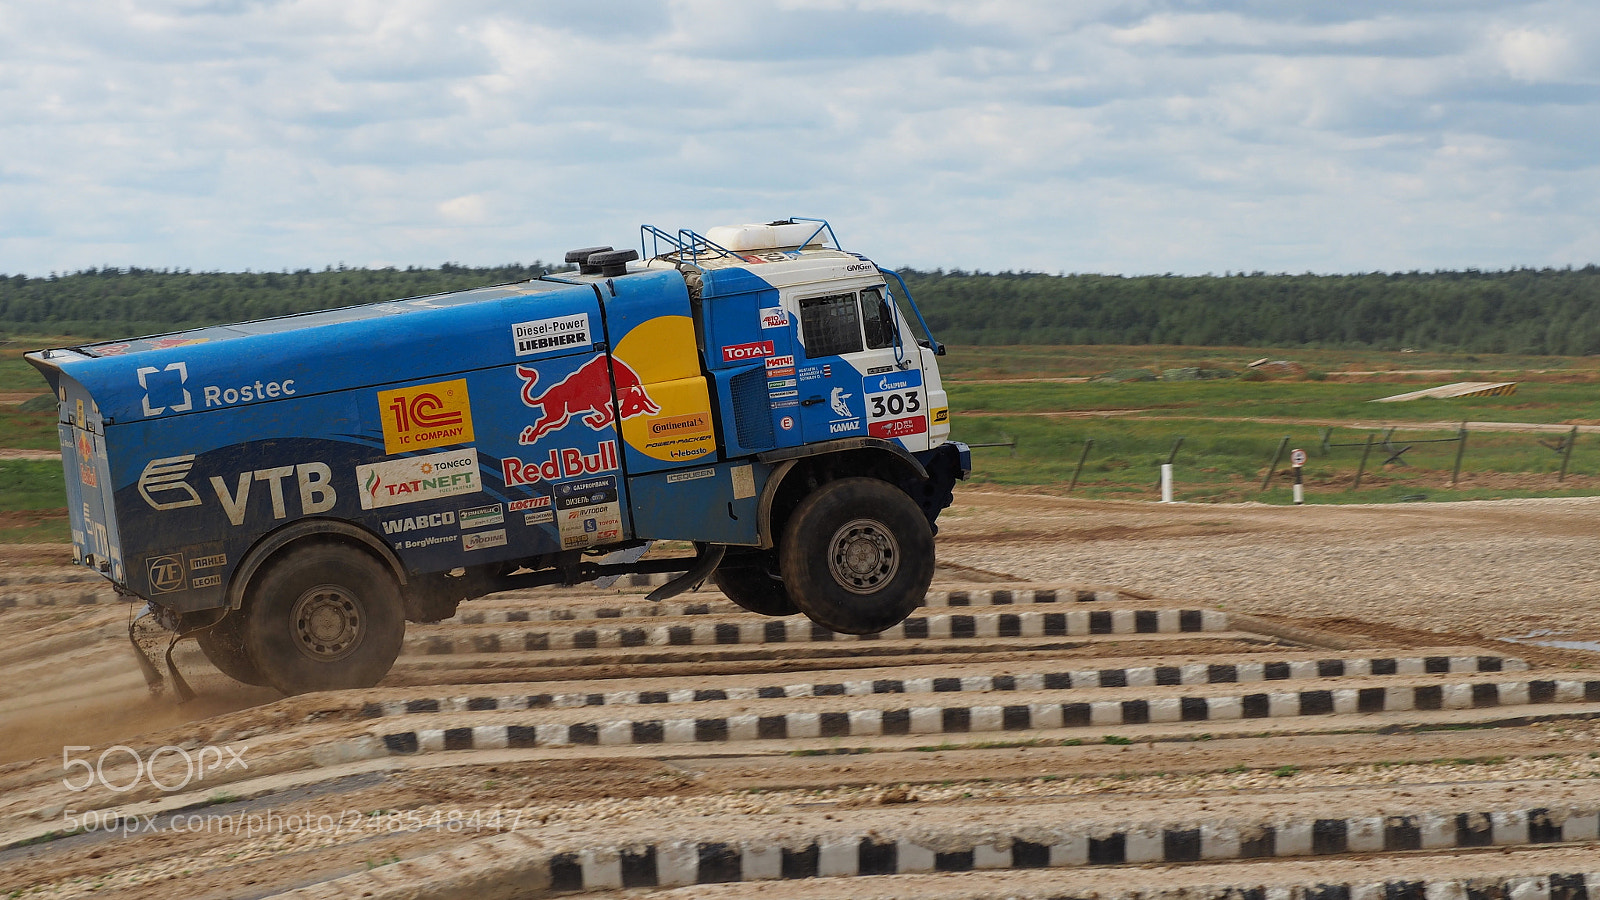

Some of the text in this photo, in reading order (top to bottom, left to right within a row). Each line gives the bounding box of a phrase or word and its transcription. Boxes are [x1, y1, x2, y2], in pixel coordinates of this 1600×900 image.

[516, 318, 585, 337] Diesel-Power
[519, 333, 586, 351] LIEBHERR
[725, 345, 772, 359] TOTAL
[204, 379, 296, 407] Rostec
[870, 391, 920, 418] 303
[652, 418, 697, 434] Continental
[784, 419, 790, 427] E
[829, 421, 860, 433] KAMAZ
[399, 428, 463, 444] 1C COMPANY
[671, 448, 707, 457] Webasto
[501, 440, 619, 487] Red Bull
[385, 472, 473, 495] TATNEFT
[573, 480, 609, 491] GAZPROMBANK
[209, 461, 337, 526] VTB
[510, 497, 549, 511] LOCTITE
[382, 511, 456, 534] WABCO
[405, 535, 458, 549] BorgWarner
[193, 555, 225, 568] MAHLE
[155, 565, 177, 584] ZF
[194, 576, 221, 587] LEONI
